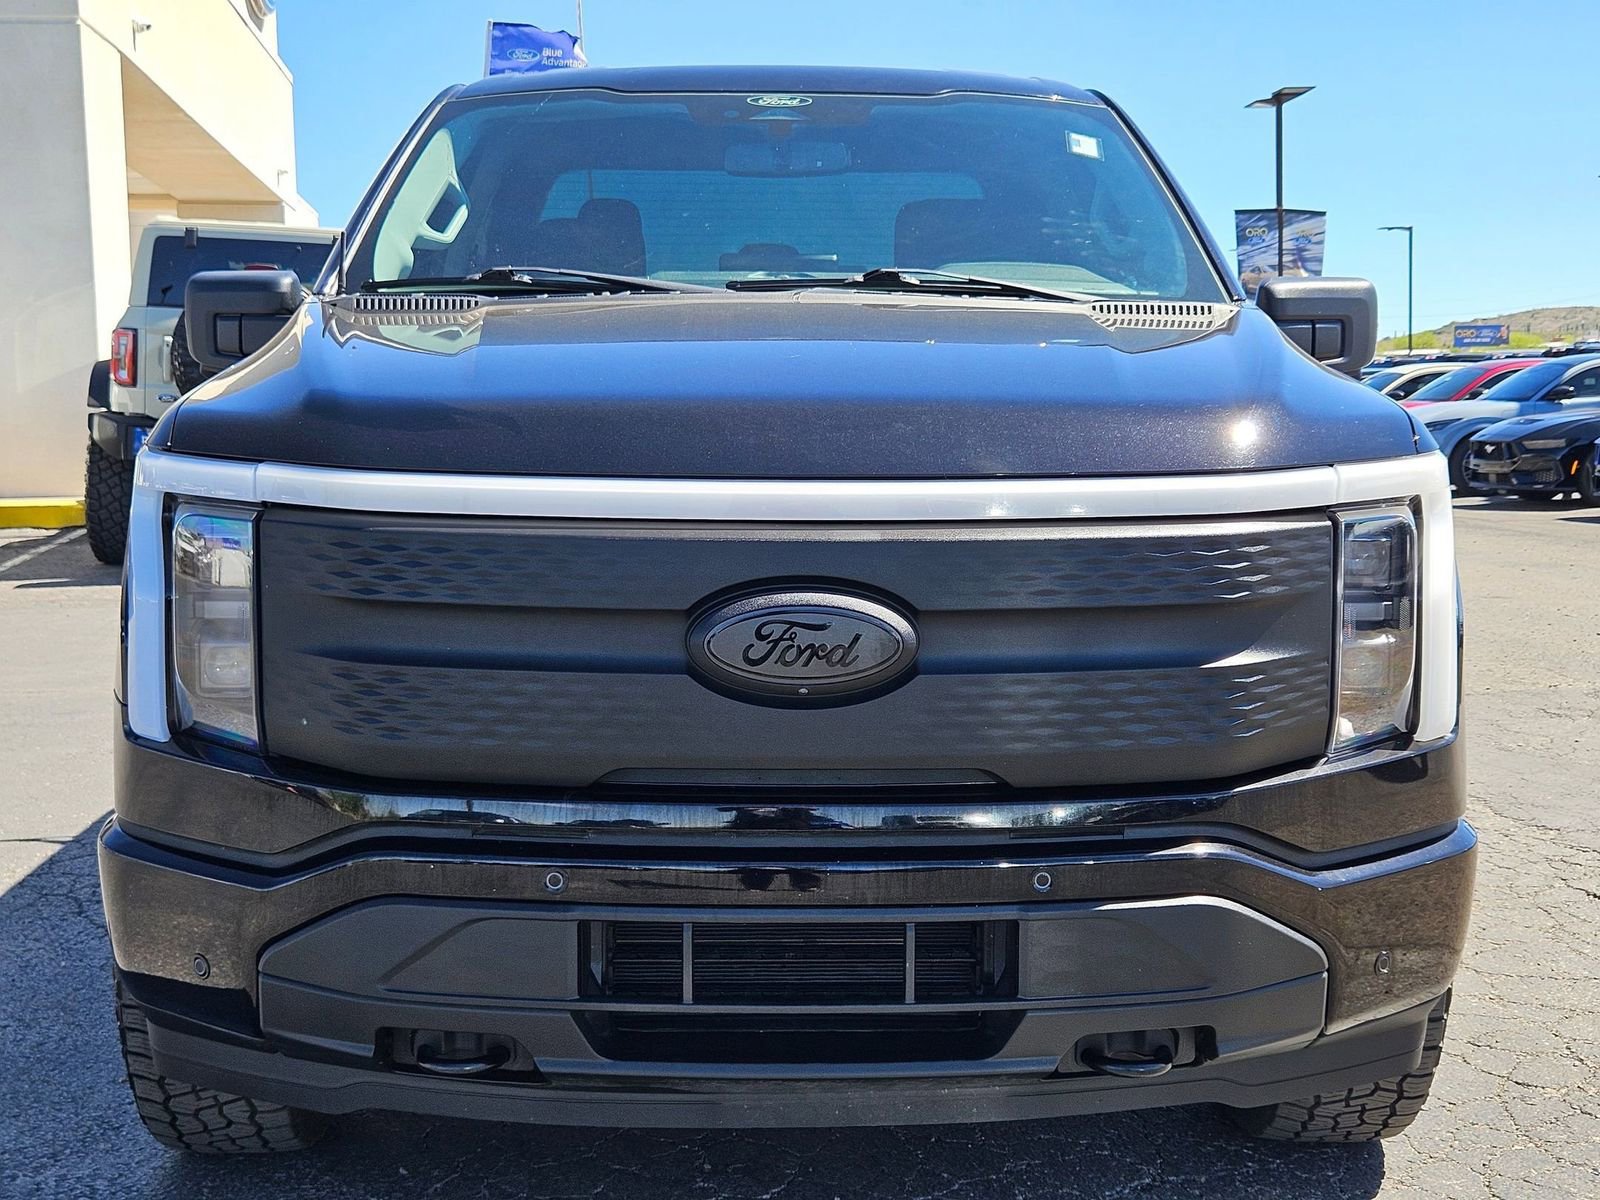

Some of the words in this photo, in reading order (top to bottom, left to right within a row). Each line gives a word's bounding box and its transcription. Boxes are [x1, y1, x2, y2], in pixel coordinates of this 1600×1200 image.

[542, 47, 563, 57] Blue
[758, 95, 801, 106] Ford
[742, 619, 863, 668] Ford
